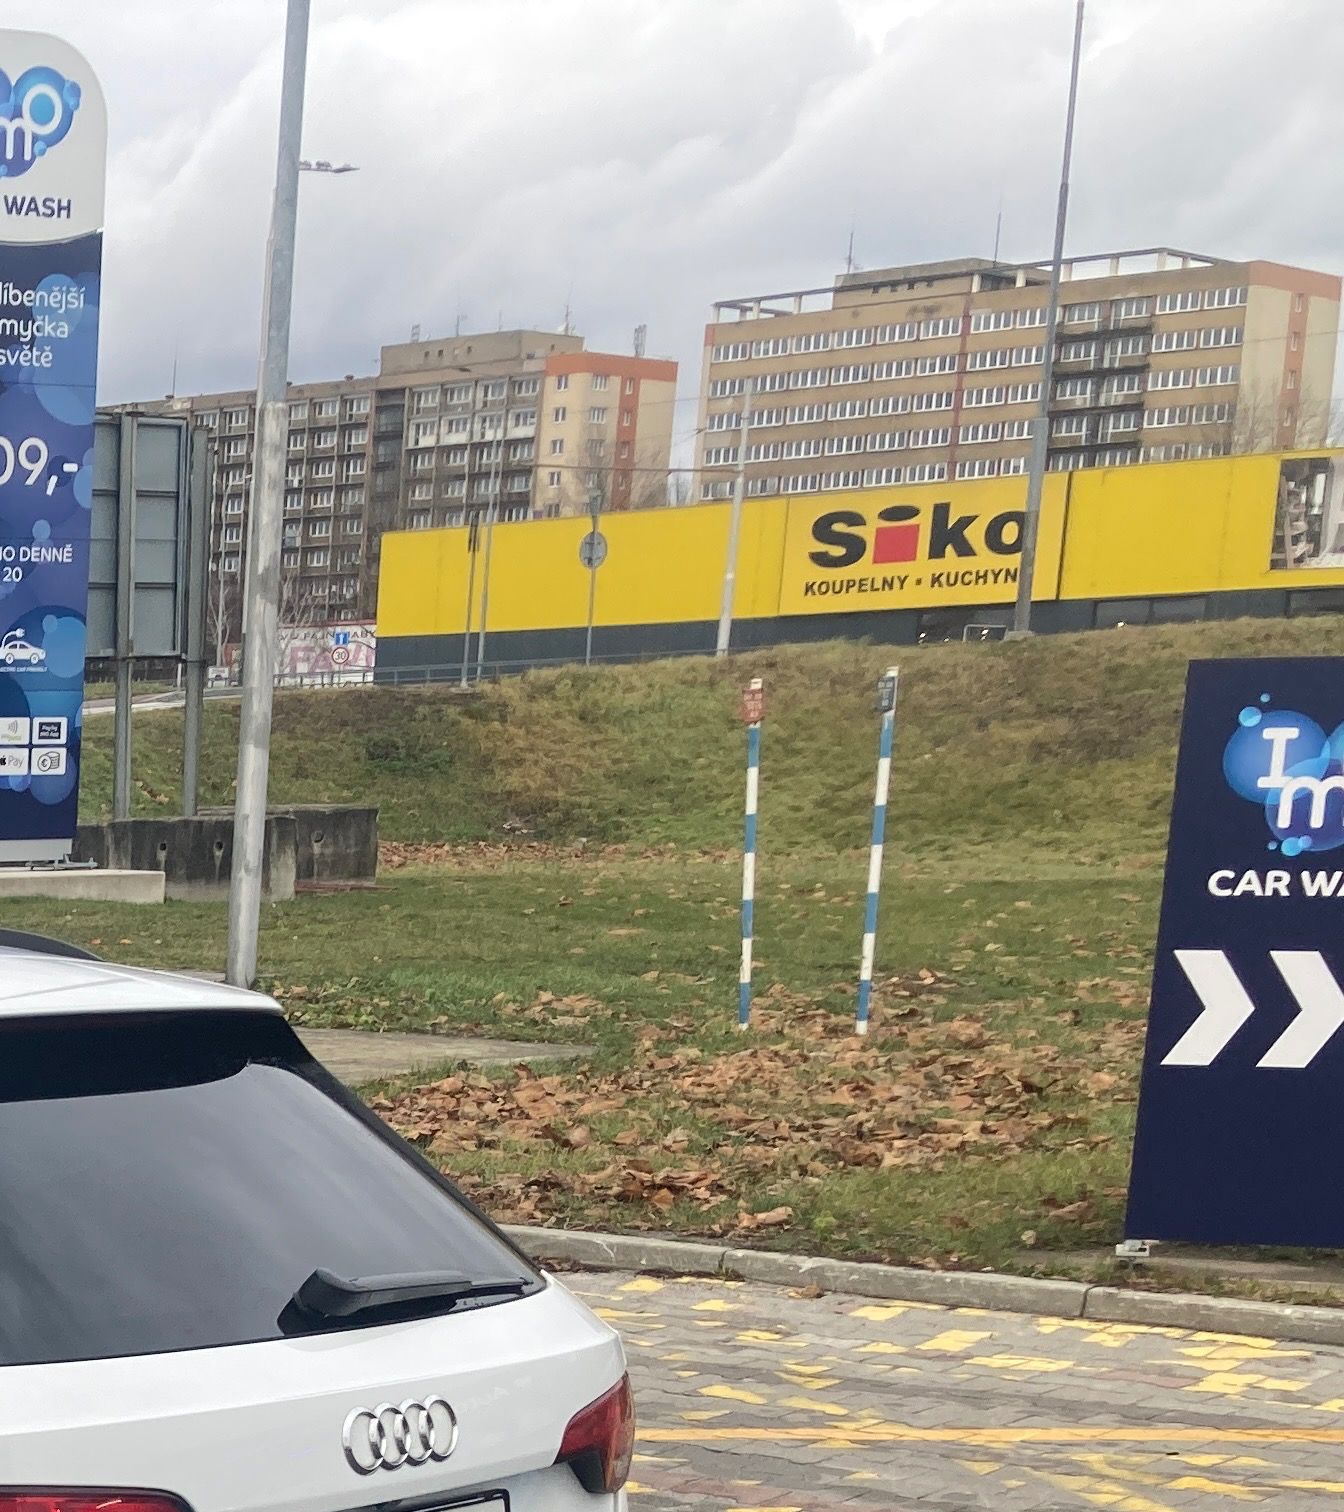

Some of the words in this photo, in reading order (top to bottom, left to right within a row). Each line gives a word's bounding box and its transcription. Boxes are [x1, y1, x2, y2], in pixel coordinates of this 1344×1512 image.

[4, 195, 72, 219] WASH
[19, 544, 73, 563] DENNĚ
[804, 574, 909, 597] KOUPELNY
[930, 567, 1018, 589] KUCHYN
[334, 651, 346, 661] 30
[8, 756, 24, 768] Pay
[1208, 870, 1291, 897] CAR
